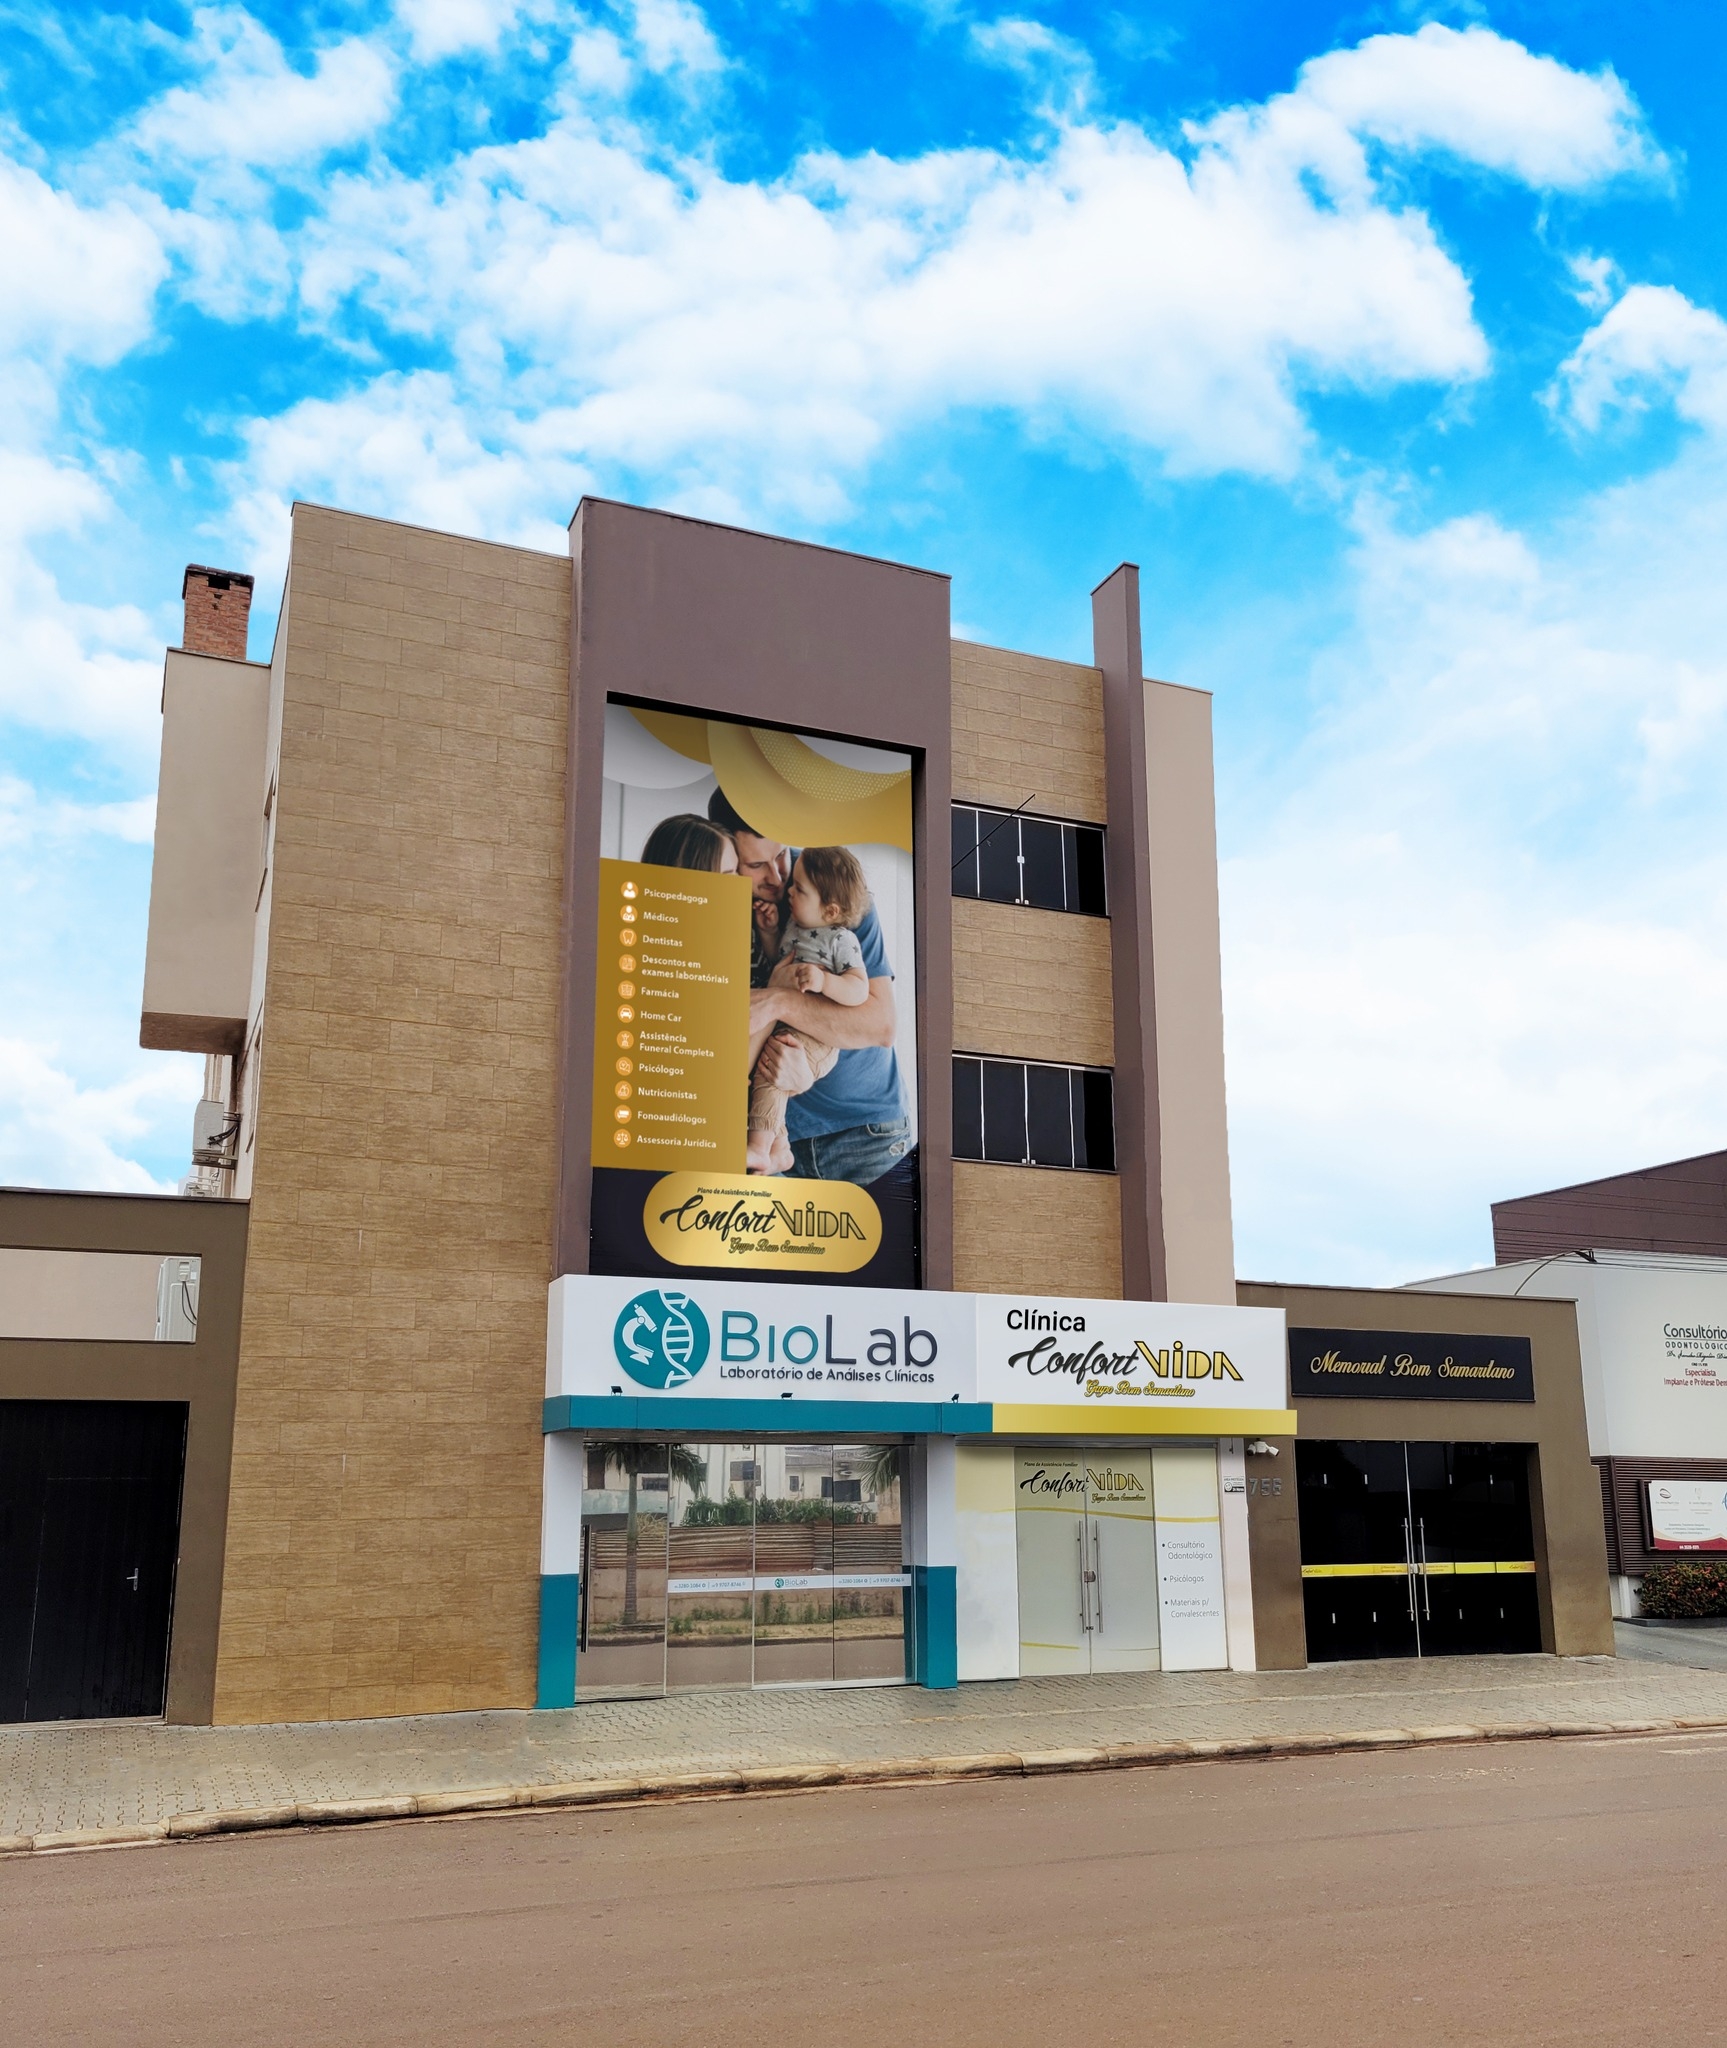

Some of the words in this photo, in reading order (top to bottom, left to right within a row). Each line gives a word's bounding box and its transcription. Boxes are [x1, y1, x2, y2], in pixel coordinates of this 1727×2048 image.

[644, 888, 708, 904] Psicopedagoga
[643, 911, 679, 924] Médicos
[642, 934, 683, 947] Dentistas
[642, 954, 686, 968] Descontos
[688, 961, 701, 969] em
[641, 968, 674, 979] exames
[676, 971, 729, 984] laboratóriais
[641, 986, 680, 999] Farmácia
[640, 1010, 666, 1022] Home
[667, 1013, 682, 1022] Car
[640, 1030, 687, 1043] Assistência
[639, 1043, 672, 1054] Funeral
[673, 1046, 715, 1058] Completa
[638, 1063, 684, 1077] Psicólogos
[637, 1087, 698, 1100] Nutricionistas
[637, 1110, 707, 1125] Fonoaudiólogos
[636, 1135, 682, 1147] Assessoria
[682, 1137, 717, 1149] Jurídica
[659, 1194, 776, 1242] Confort
[1006, 1309, 1086, 1332] Clínica
[1664, 1323, 1727, 1339] Consultório
[720, 1310, 938, 1367] BioLab
[1008, 1336, 1140, 1384] Confort
[1310, 1350, 1387, 1375] Memorial
[1389, 1353, 1432, 1378] Bom
[1437, 1356, 1516, 1380] Samaritano
[720, 1366, 804, 1380] Laboratório
[806, 1368, 824, 1381] de
[826, 1367, 882, 1383] Análises
[884, 1369, 935, 1383] Clínicas
[1684, 1368, 1717, 1378] Especialista
[1115, 1380, 1142, 1395] Bom
[1663, 1378, 1689, 1387] Implante
[1694, 1378, 1715, 1387] Prótese
[1167, 1541, 1205, 1549] Consultório
[1168, 1552, 1213, 1560] Odontológico
[1169, 1574, 1205, 1584] Psicólogos
[1170, 1598, 1200, 1607] Materiais
[1171, 1610, 1220, 1618] Convalescentes
